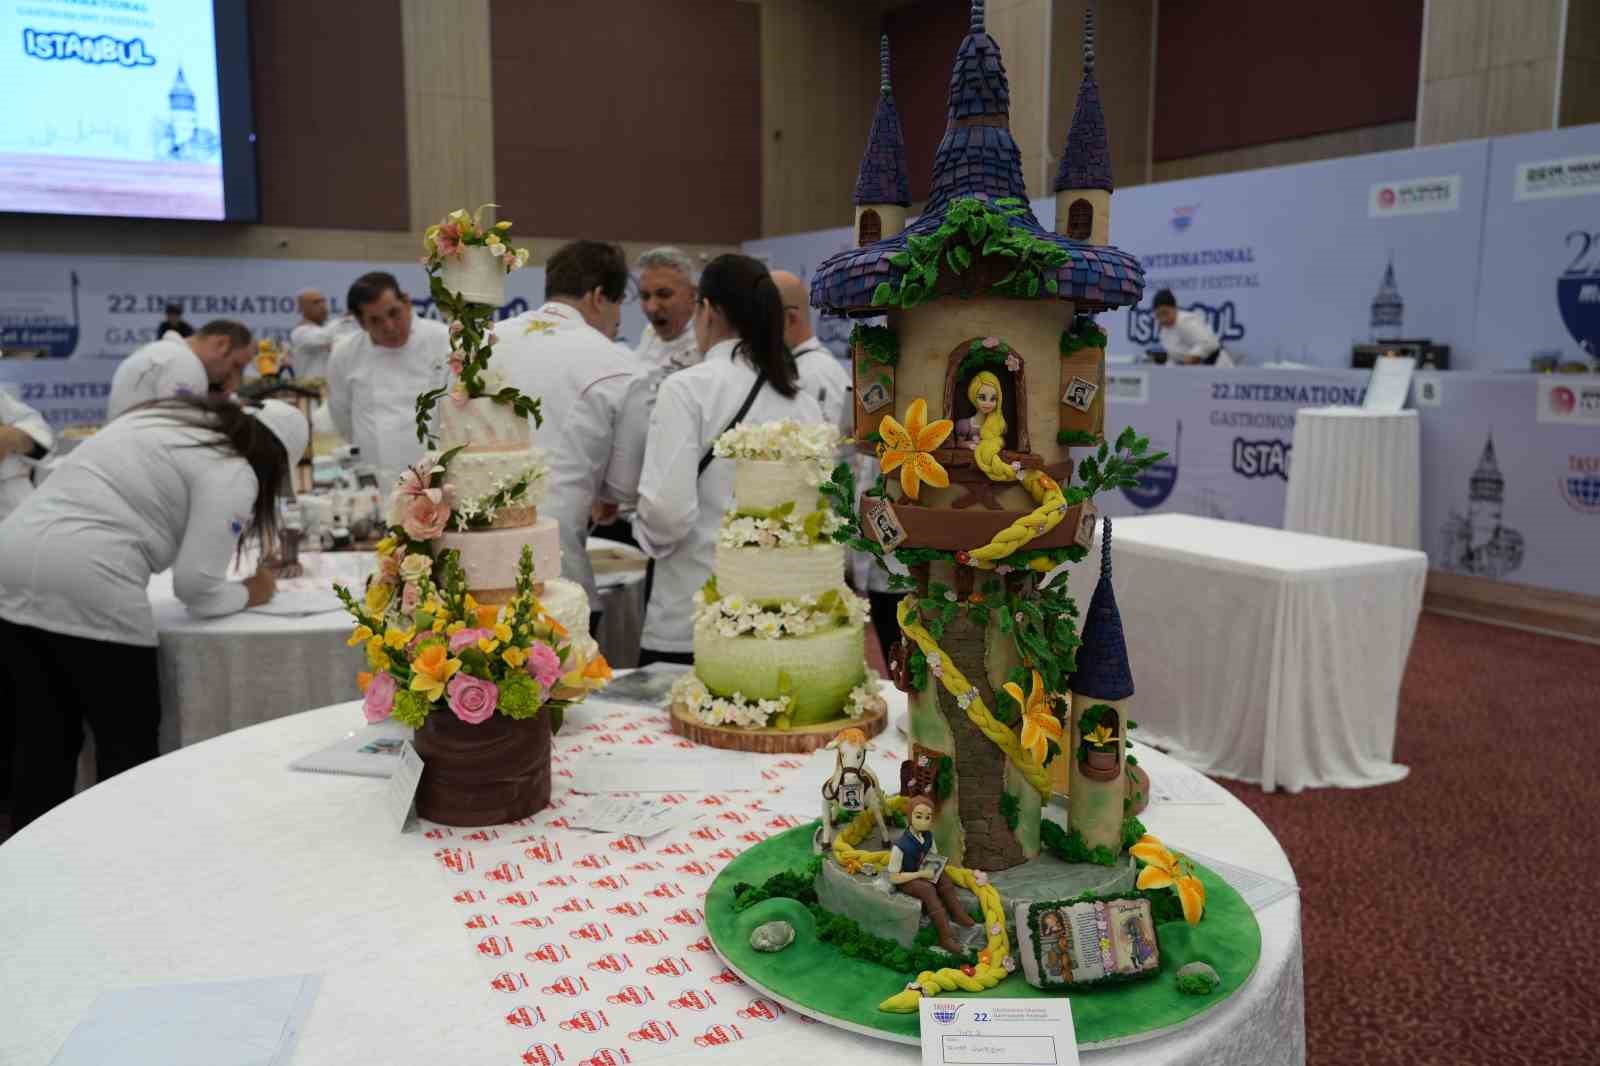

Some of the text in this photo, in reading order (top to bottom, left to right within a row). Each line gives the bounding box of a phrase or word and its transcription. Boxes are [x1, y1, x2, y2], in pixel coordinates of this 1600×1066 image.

[24, 28, 156, 67] ISTANBUL
[1564, 230, 1600, 276] 2
[1233, 437, 1293, 481] ISTA
[973, 1012, 992, 1022] 22.
